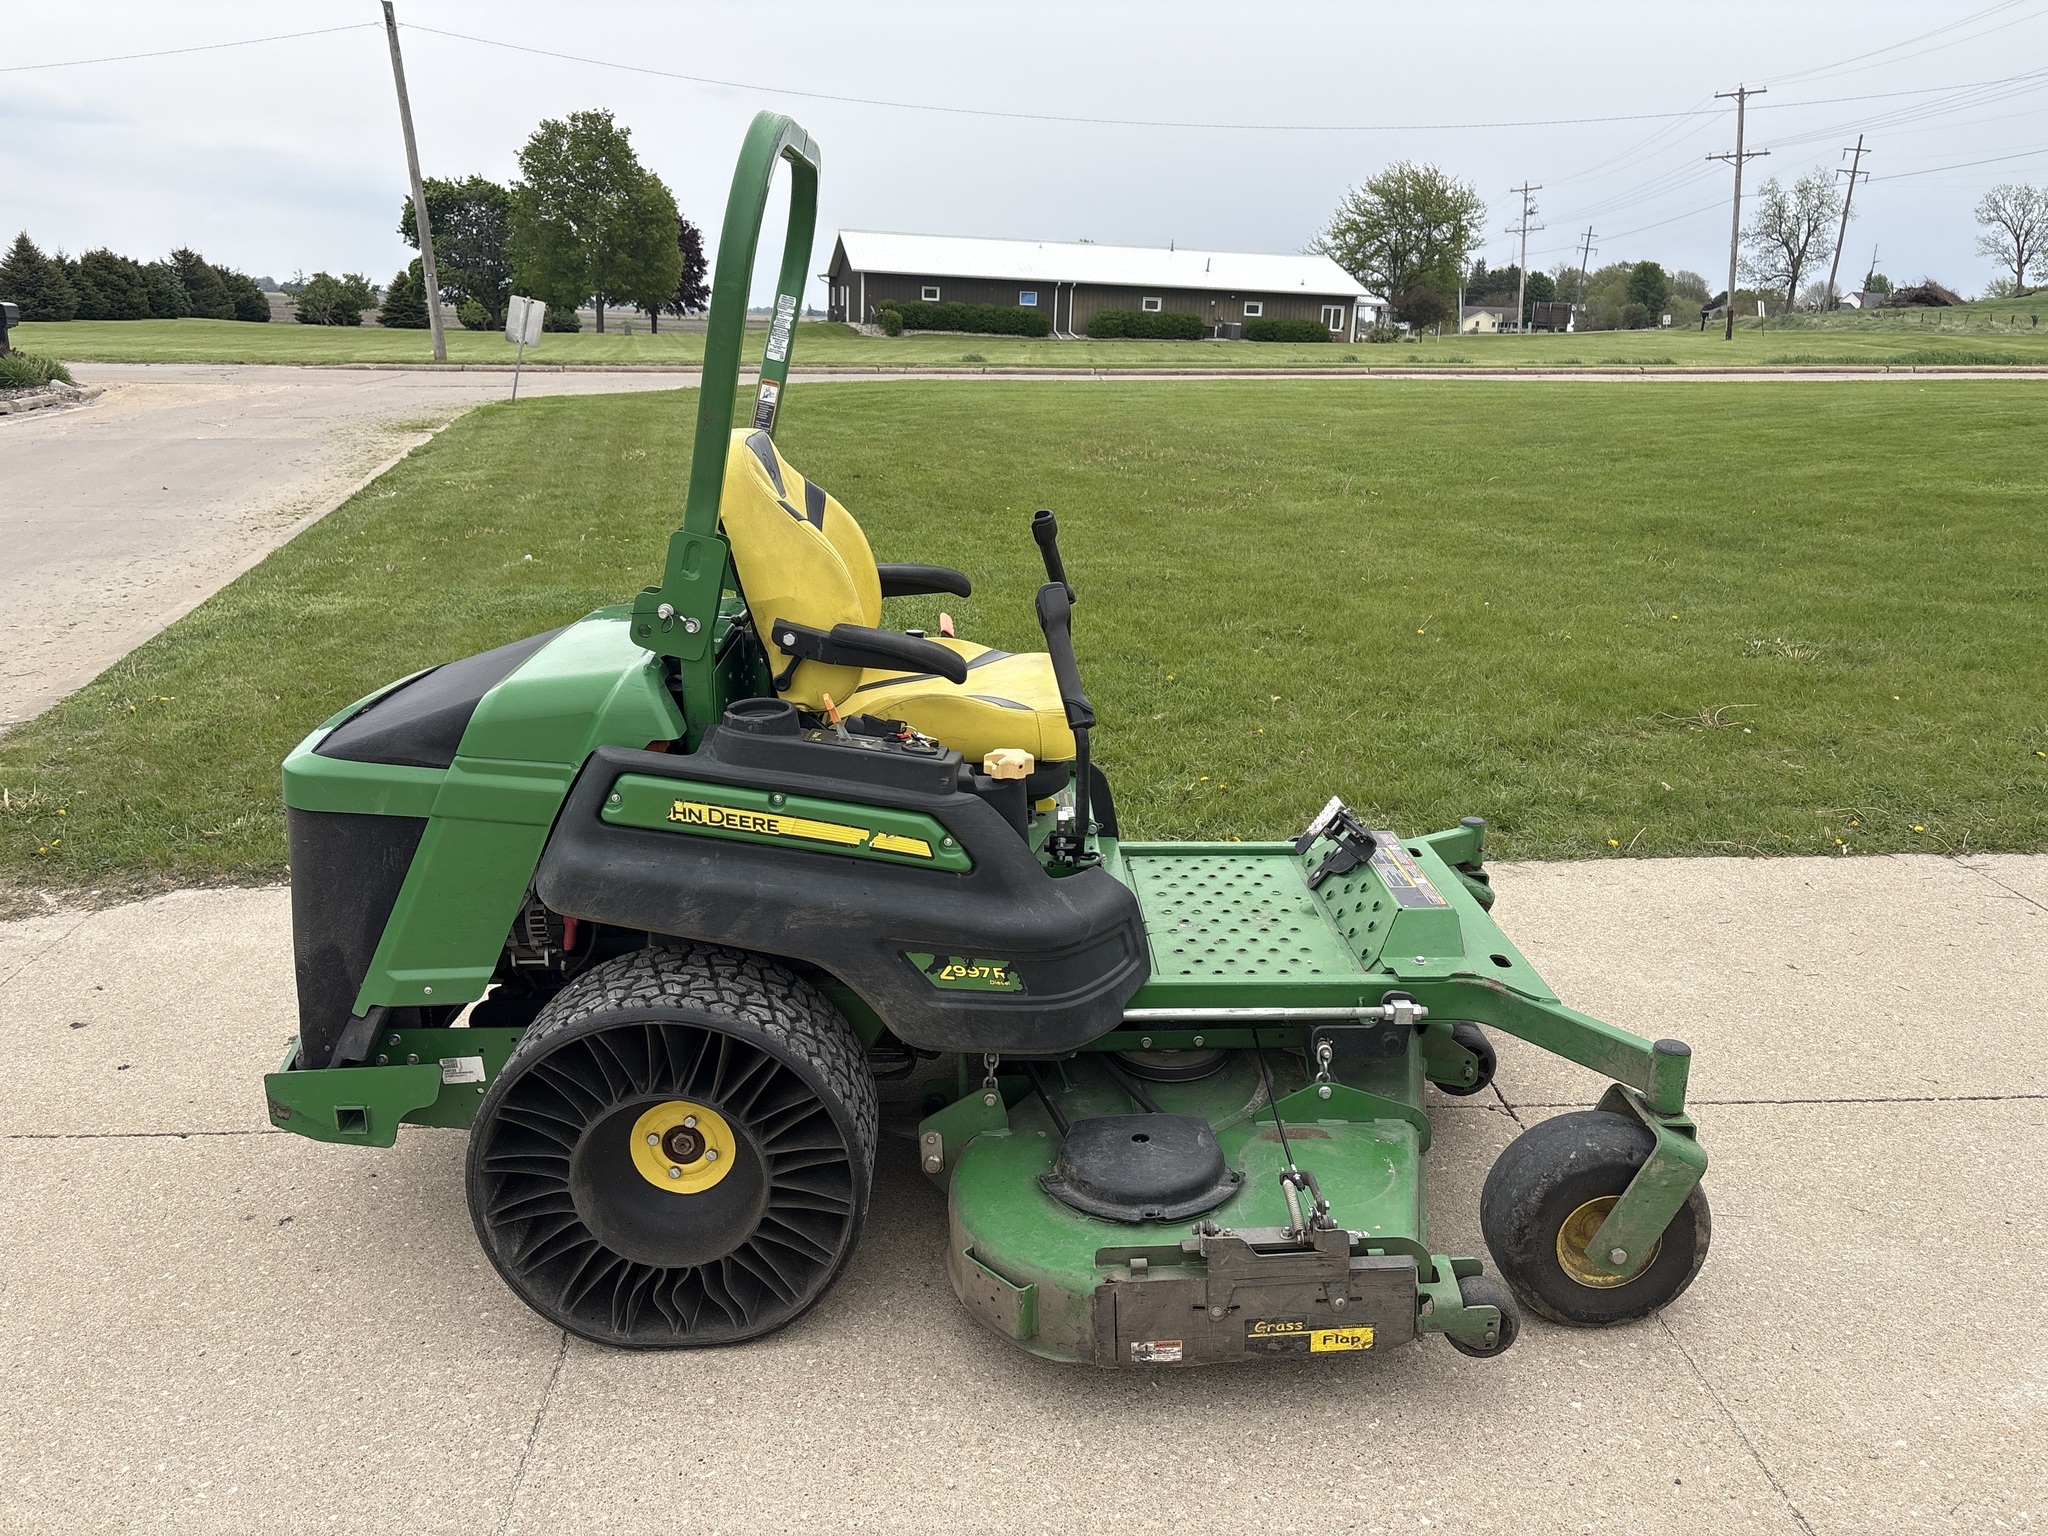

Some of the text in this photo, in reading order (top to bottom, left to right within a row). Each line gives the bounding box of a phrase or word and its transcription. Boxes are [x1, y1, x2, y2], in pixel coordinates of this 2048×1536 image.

[668, 806, 779, 832] HN DEERE
[1254, 1321, 1303, 1333] Grass
[1323, 1334, 1361, 1345] Flap
